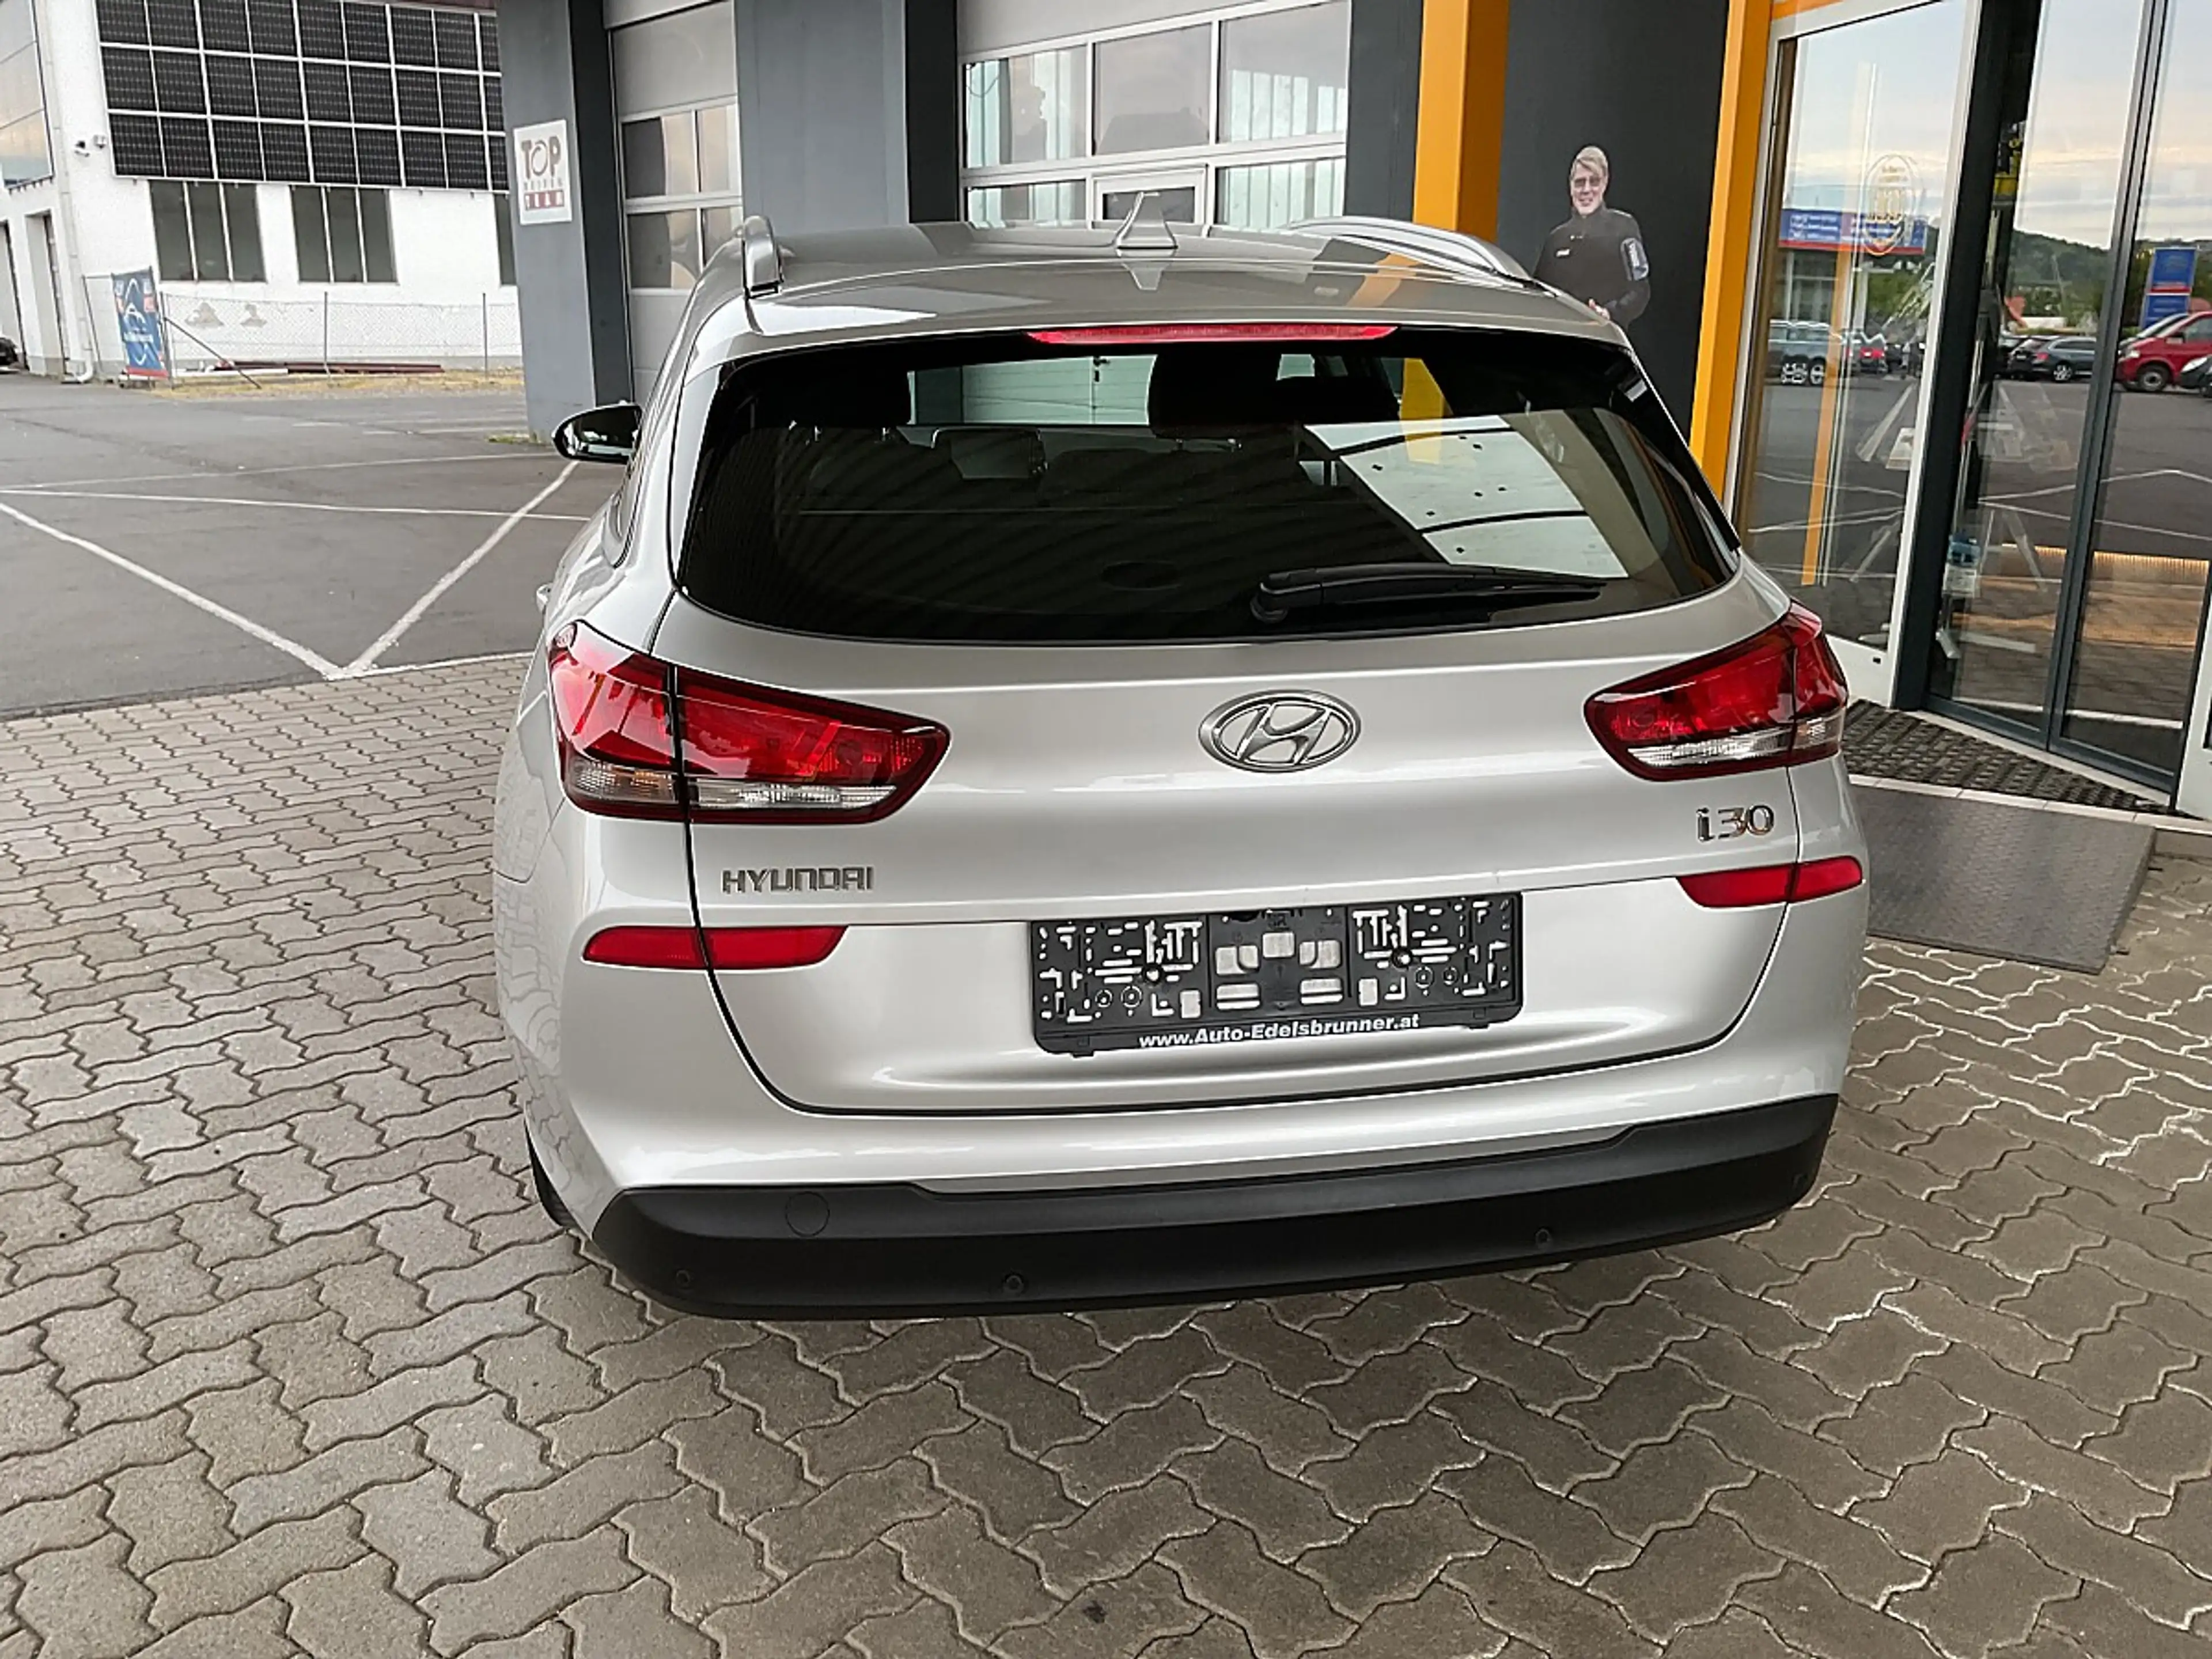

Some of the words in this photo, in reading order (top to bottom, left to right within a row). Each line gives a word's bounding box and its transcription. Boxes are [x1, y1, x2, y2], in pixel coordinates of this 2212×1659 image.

[521, 136, 561, 180] TOP
[1696, 805, 1774, 842] i30
[722, 866, 874, 893] HYUNDAI
[1139, 1013, 1419, 1047] www.Auto-Edelsbrunner.at
